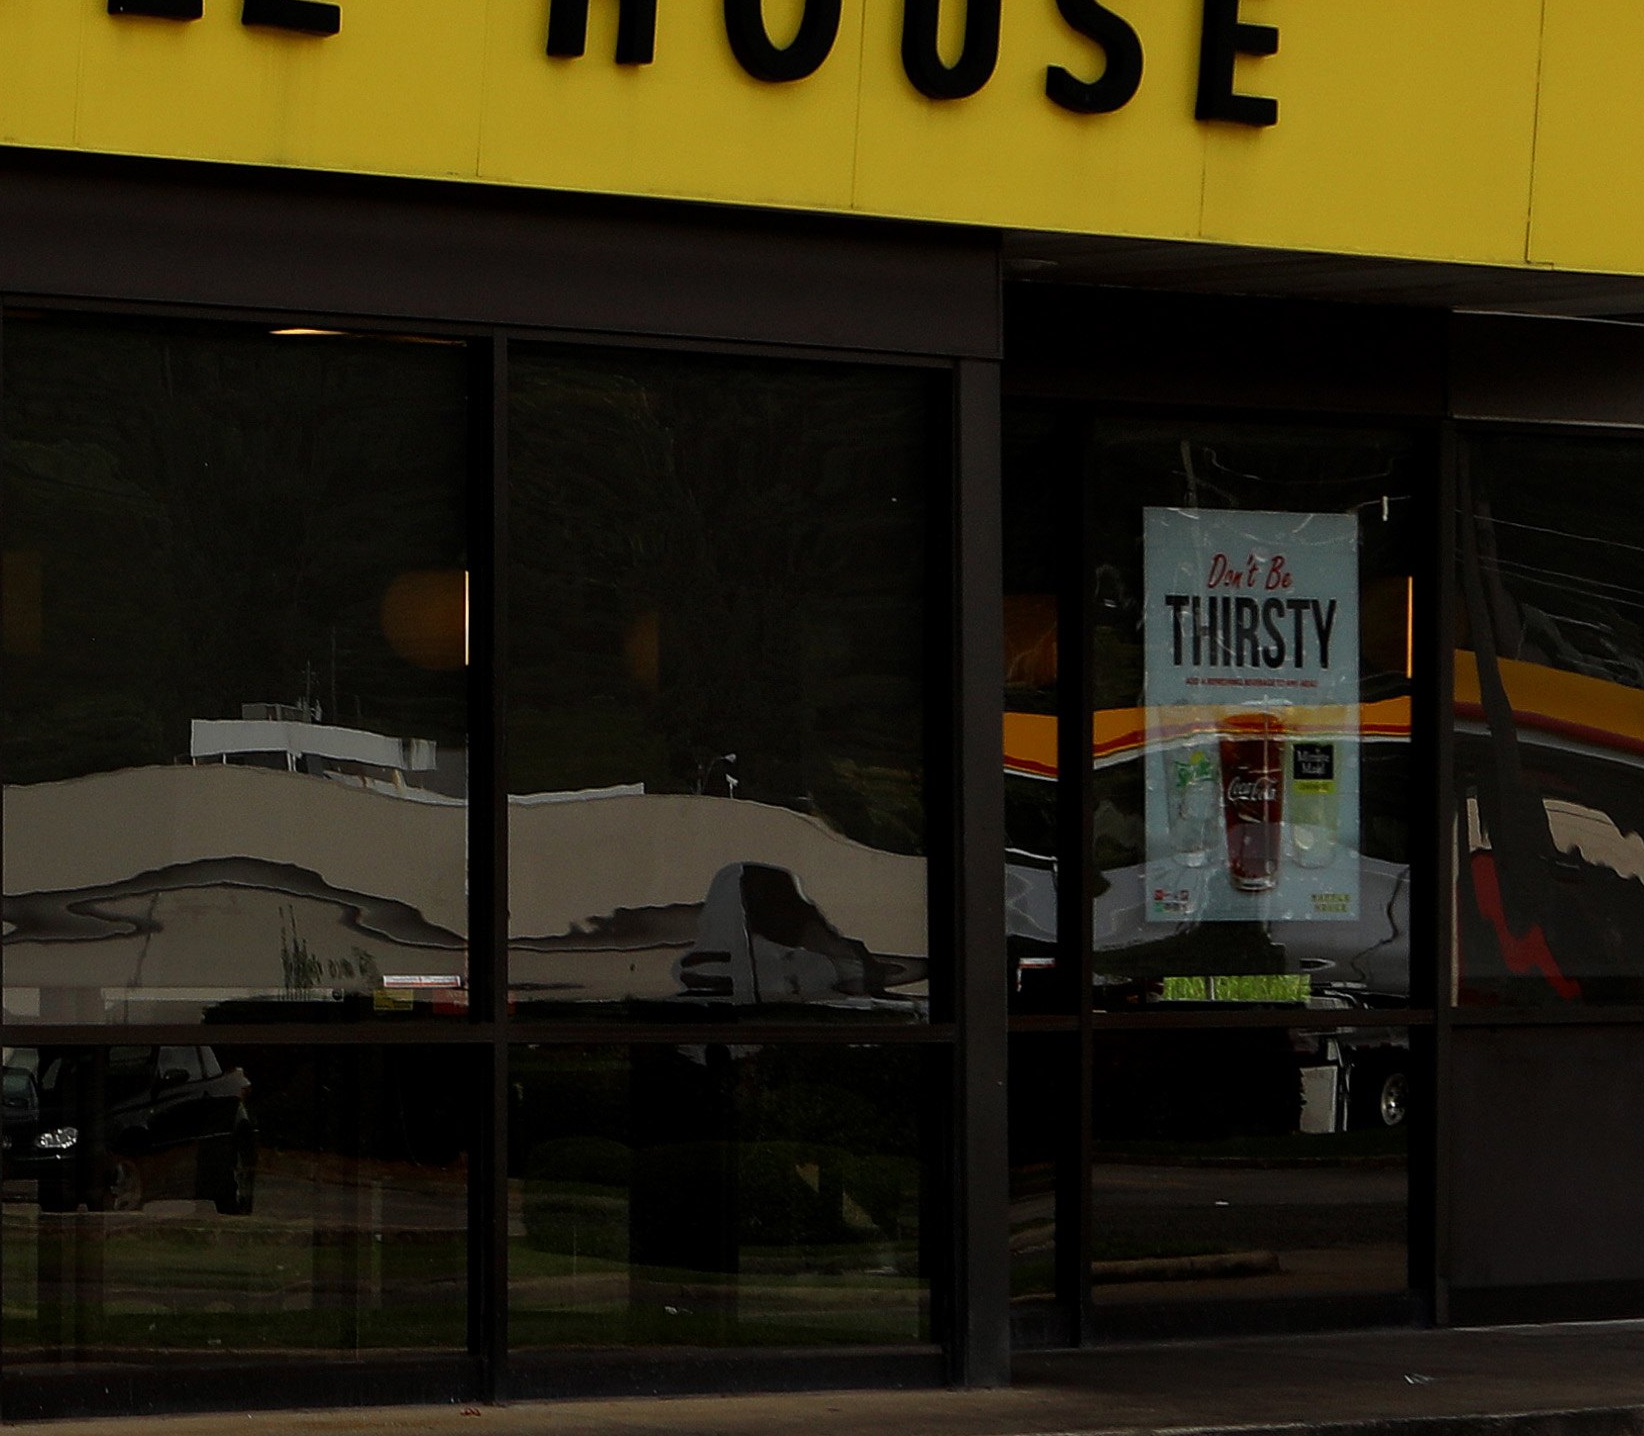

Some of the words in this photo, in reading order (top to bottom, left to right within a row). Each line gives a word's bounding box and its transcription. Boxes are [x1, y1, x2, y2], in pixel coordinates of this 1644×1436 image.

[1208, 553, 1258, 588] Don't
[1265, 555, 1292, 590] Be
[1165, 595, 1337, 669] THIRSTY
